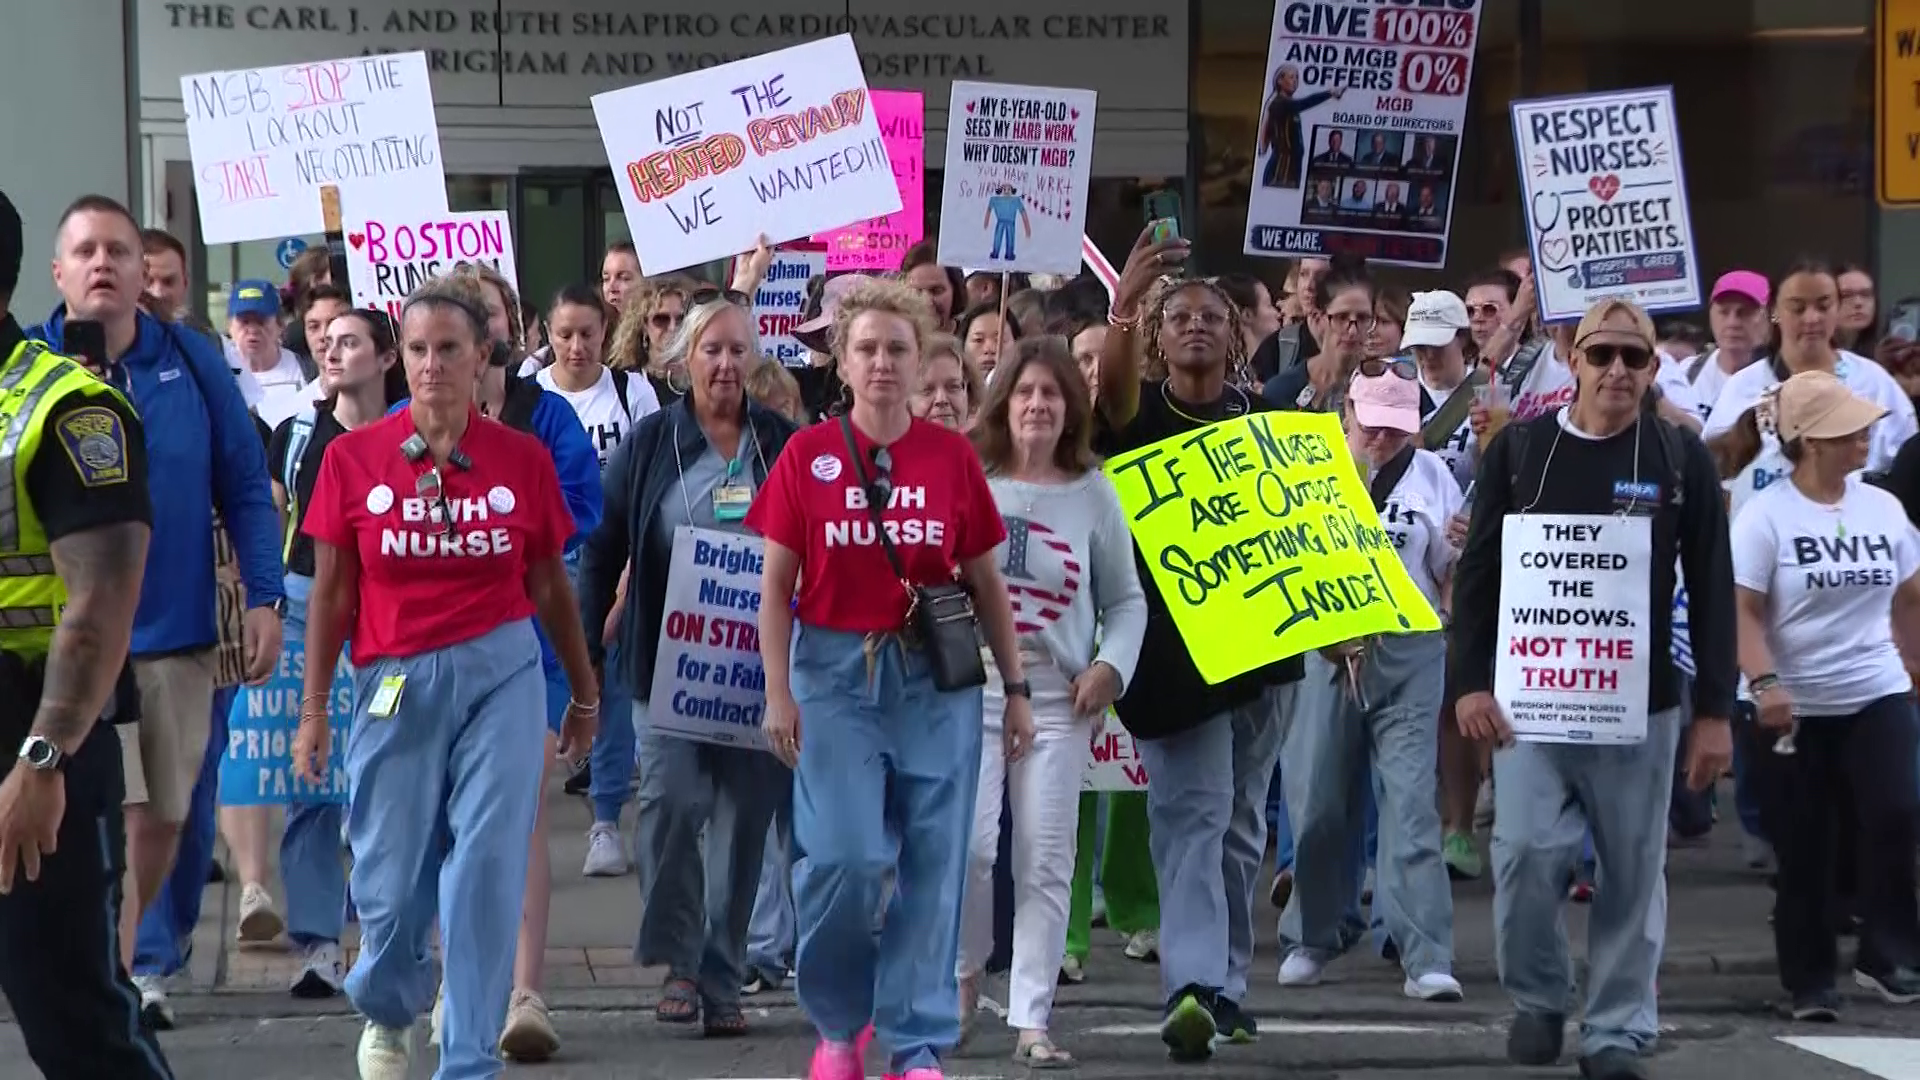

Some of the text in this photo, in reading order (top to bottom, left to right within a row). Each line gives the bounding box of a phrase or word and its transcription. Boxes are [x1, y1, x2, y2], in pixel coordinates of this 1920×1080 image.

[165, 3, 1171, 38] THE CARL J. AND RUTH SHAPIRO CARDIOVASCULAR CENTER
[1284, 3, 1467, 46] GIVE 100%
[424, 48, 566, 76] RIGHAM
[581, 51, 654, 76] AND
[862, 53, 994, 78] OSPITAL
[1285, 42, 1460, 94] AND MGB 0%
[283, 62, 351, 110] STOP
[1303, 65, 1393, 92] OFFERS
[656, 73, 792, 145] NOT THE
[979, 96, 1066, 121] MY 6-YEAR-OLD
[1376, 96, 1413, 112] MGB
[965, 118, 1077, 143] SEES MY HARD WORK.
[1332, 112, 1454, 131] BOARD OF DIRECTORS
[1530, 101, 1659, 145] RESPECT
[627, 87, 866, 203] HEATED RIVALRY
[963, 142, 1076, 168] WHY DOESN'T MGB?
[202, 134, 434, 203] START NEGOTIATING
[666, 186, 722, 235] WE
[1567, 197, 1672, 231] PROTECT
[365, 219, 504, 263] BOSTON
[1261, 227, 1284, 249] WE
[1284, 229, 1322, 251] CARE.
[1571, 224, 1685, 258] PATIENTS.
[763, 260, 811, 283] gham
[1114, 415, 1333, 521] IF THE NURSES
[403, 496, 489, 523] BWH
[845, 486, 926, 510] BH
[1189, 491, 1249, 532] ARE
[381, 528, 513, 558] NURSE
[825, 518, 945, 548] NURSE
[1542, 524, 1603, 542] THEY
[693, 539, 765, 576] Brigha
[1159, 521, 1329, 606] SOMETHING
[1322, 513, 1349, 551] IS
[1520, 552, 1628, 571] COVERED
[1793, 533, 1893, 566] BWH
[1548, 580, 1594, 598] THE
[1806, 568, 1893, 590] NURSES
[666, 610, 706, 644] ON
[1511, 608, 1636, 628] WINDOWS.
[1510, 636, 1634, 660] NOT THE
[676, 652, 711, 683] for
[712, 663, 727, 686] a
[1521, 667, 1618, 690] TRUTH
[1510, 700, 1626, 713] BRIGHAM UNION NURSES
[1513, 711, 1536, 721] WILL
[1538, 713, 1558, 722] NOT
[1561, 713, 1587, 723] BACK
